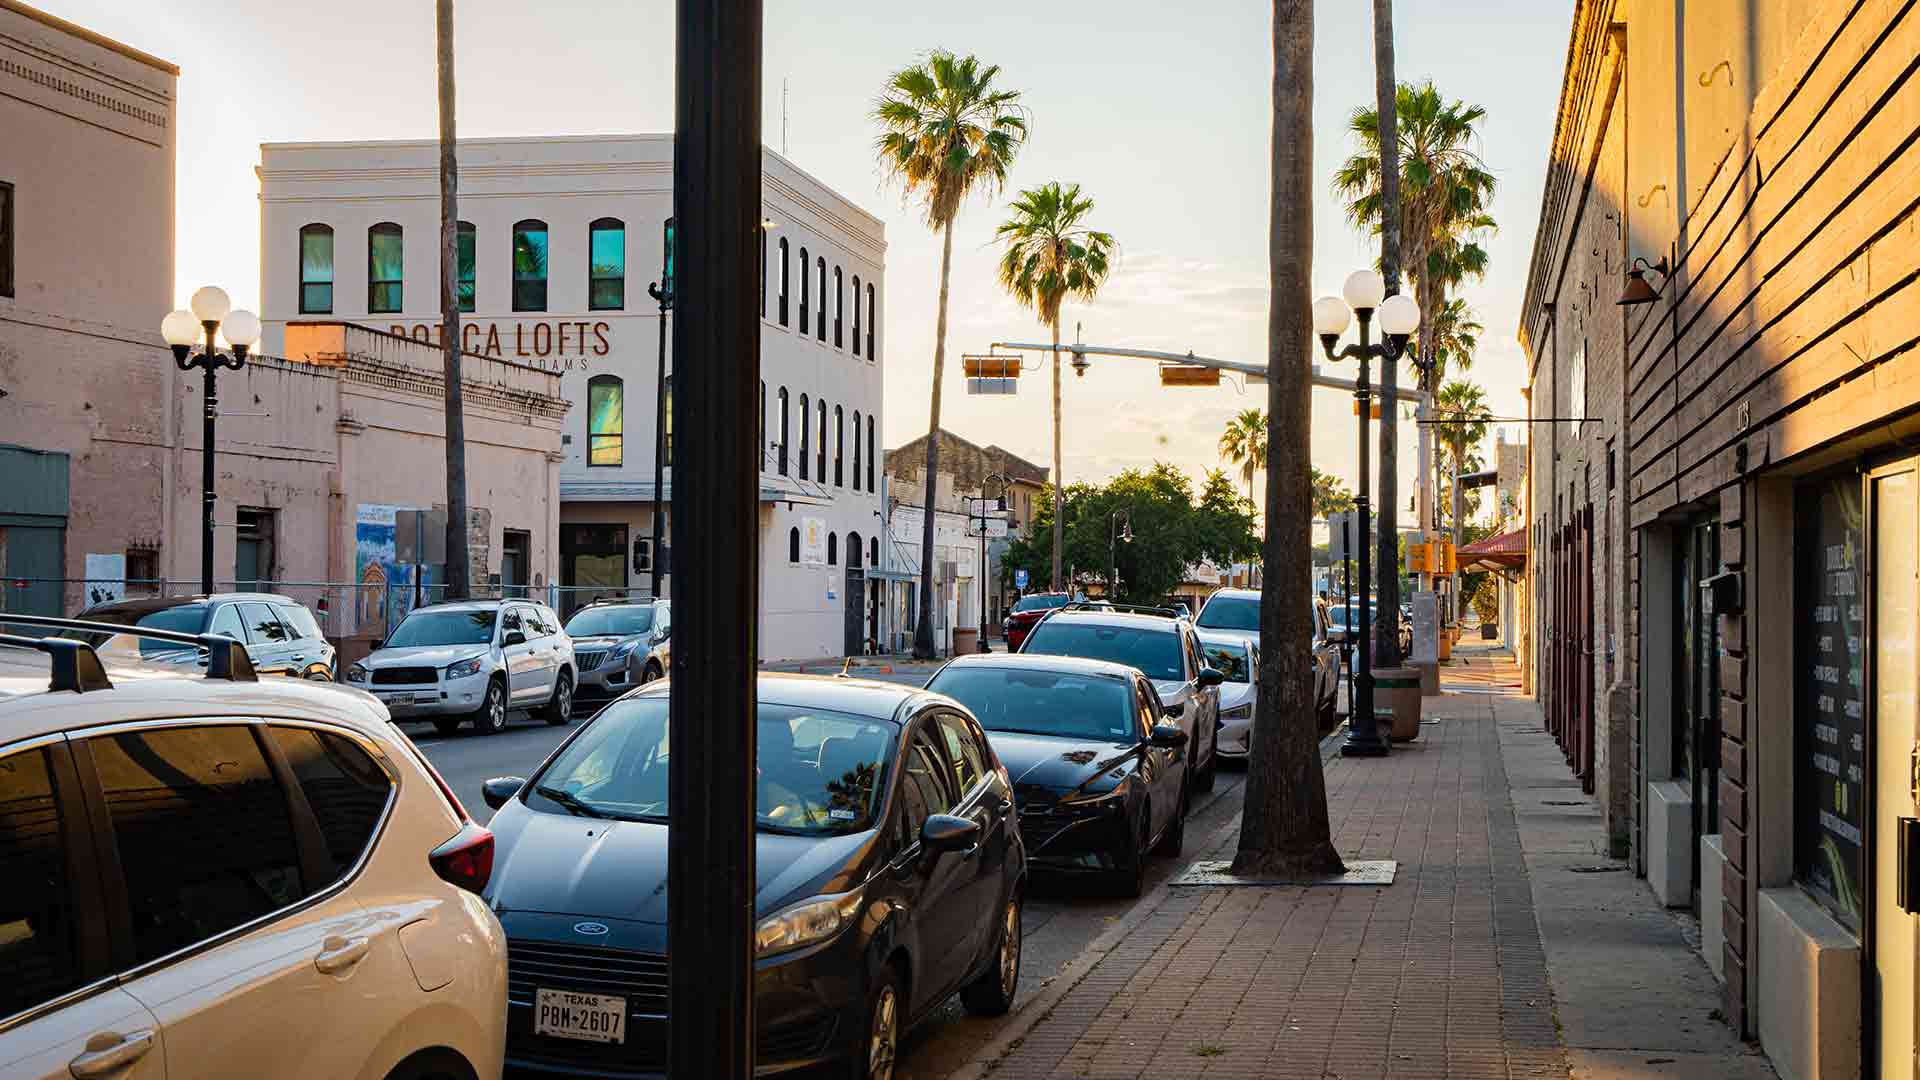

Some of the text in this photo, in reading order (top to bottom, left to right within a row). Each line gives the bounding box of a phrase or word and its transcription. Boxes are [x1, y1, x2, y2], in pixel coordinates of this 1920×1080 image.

[390, 321, 610, 356] OTCA LOFTS
[527, 358, 589, 370] ADAMS
[564, 994, 599, 1006] TEXAS
